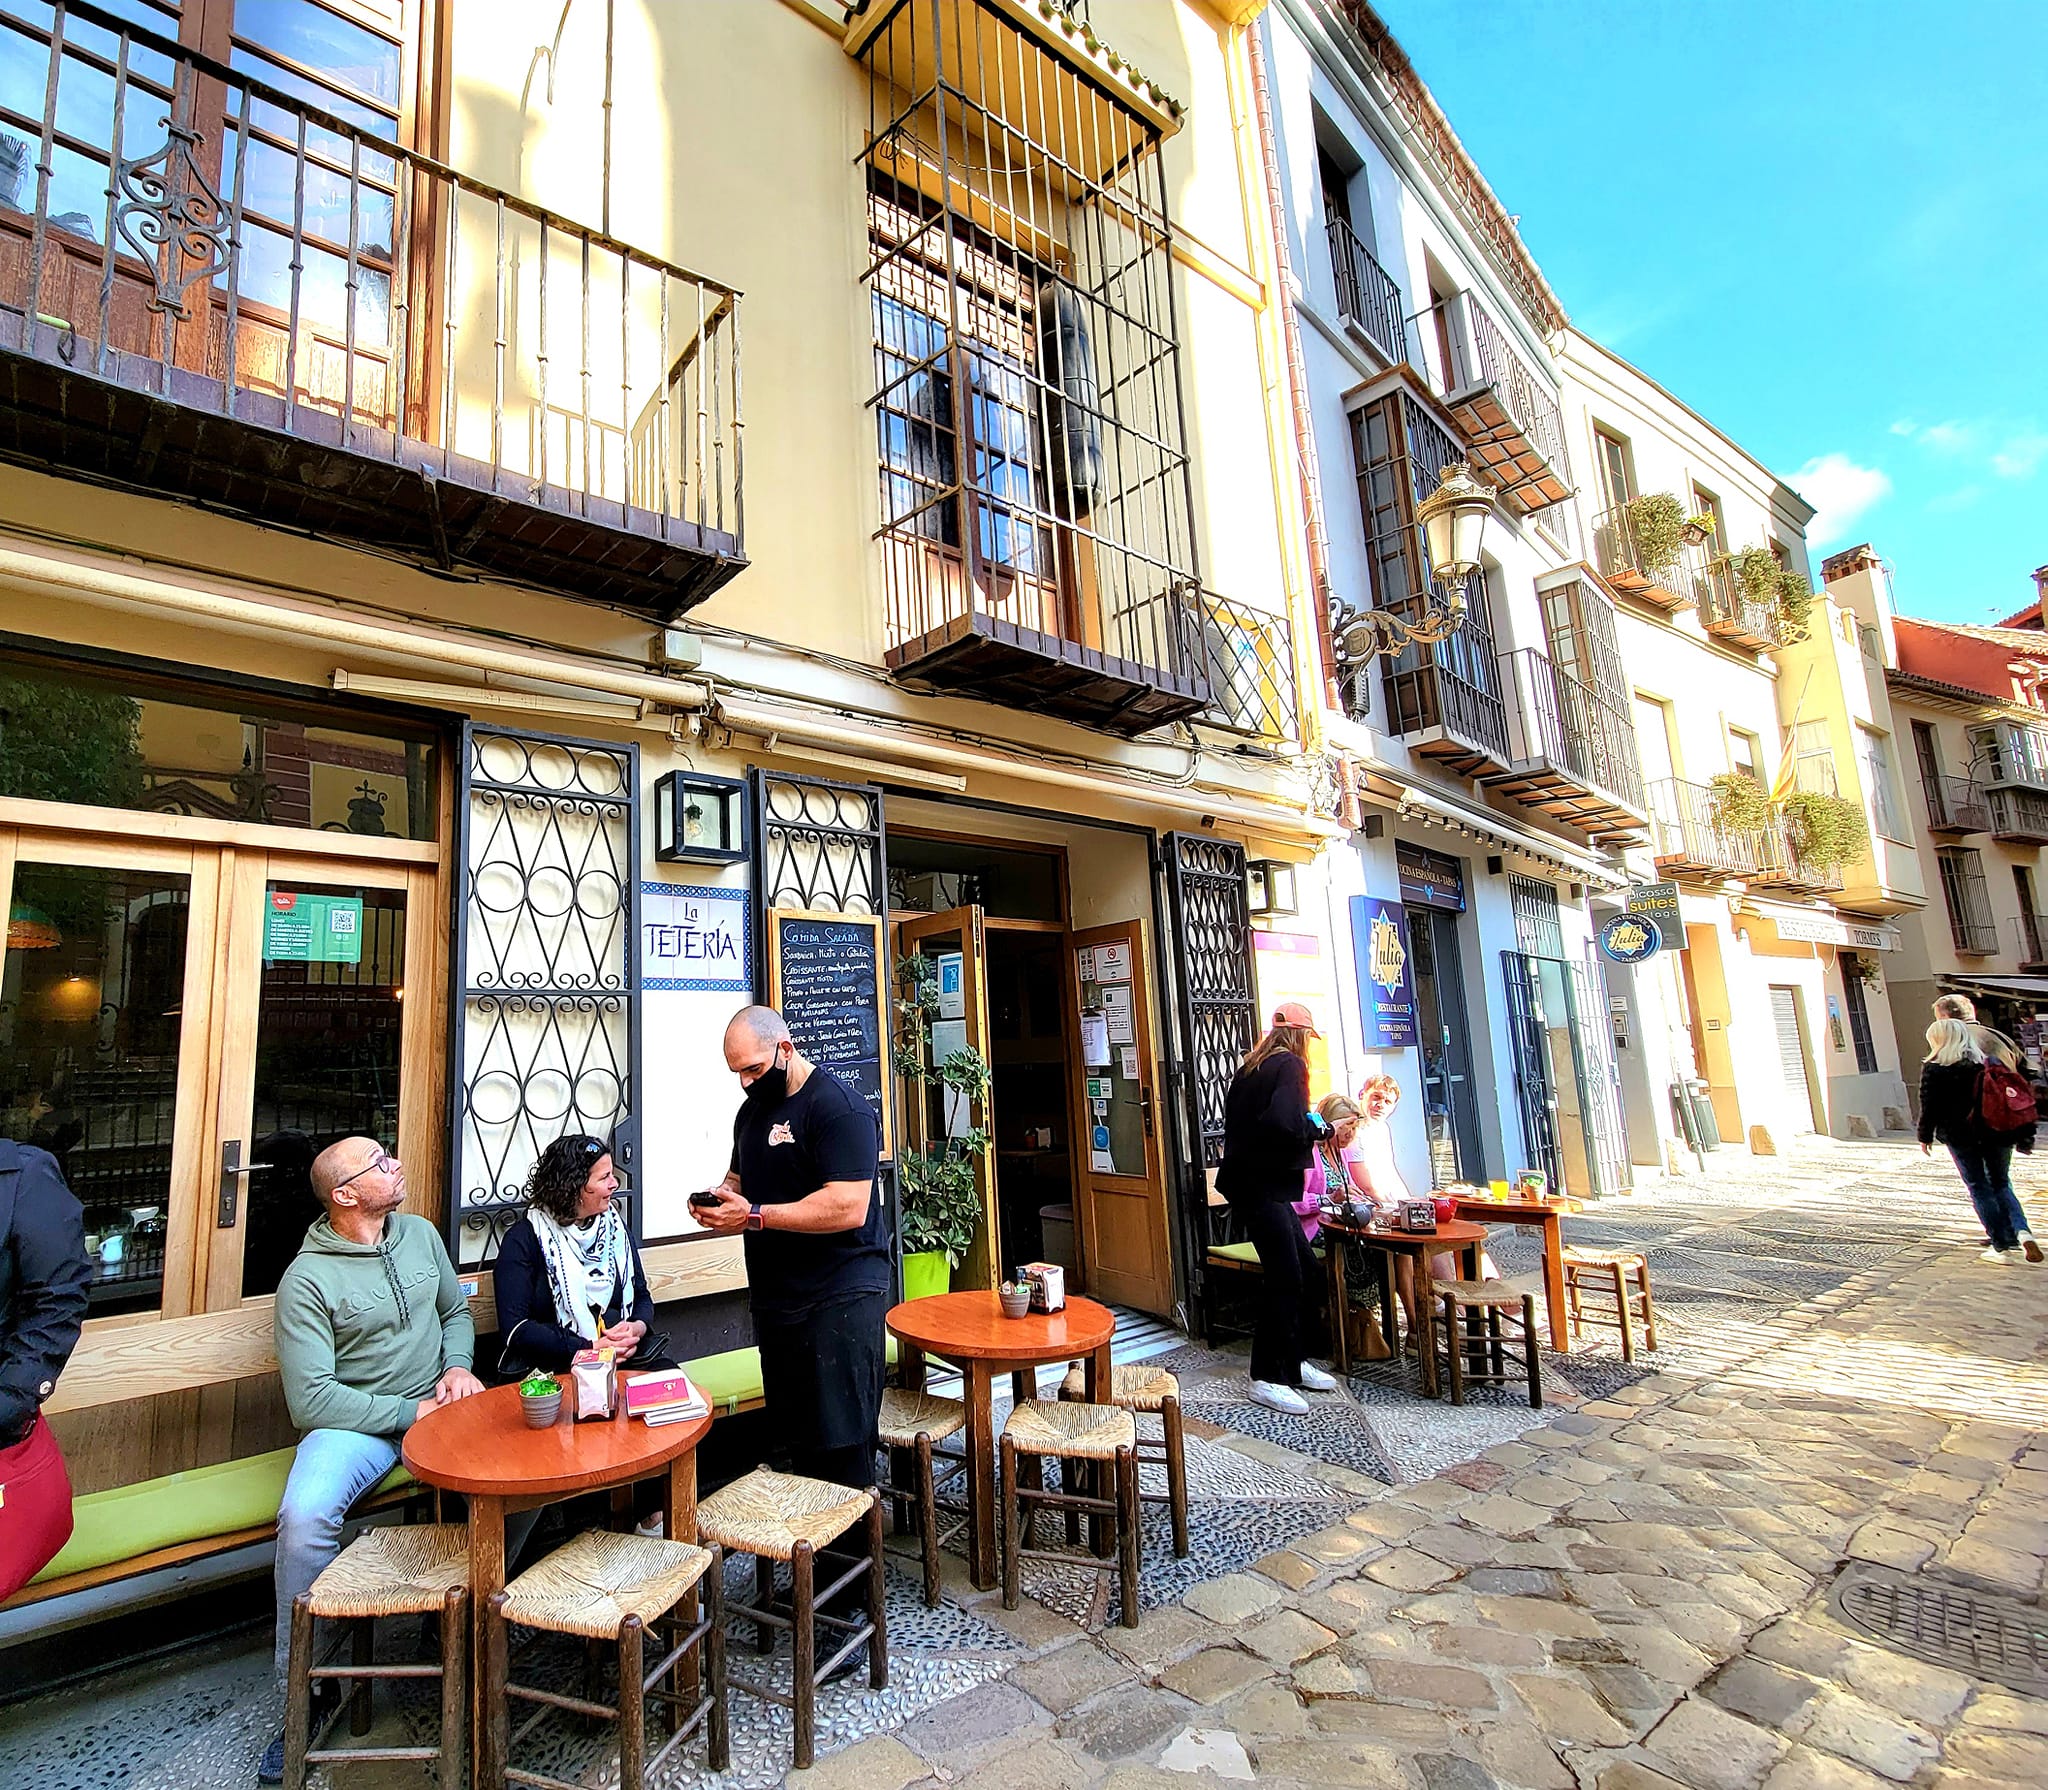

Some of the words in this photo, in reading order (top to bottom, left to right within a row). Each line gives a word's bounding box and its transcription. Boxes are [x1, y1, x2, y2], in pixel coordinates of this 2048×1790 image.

[684, 902, 698, 922] La
[1629, 898, 1677, 913] suites
[643, 919, 737, 960] TETERÍA
[1610, 929, 1645, 949] Julia
[1372, 929, 1402, 978] Julia
